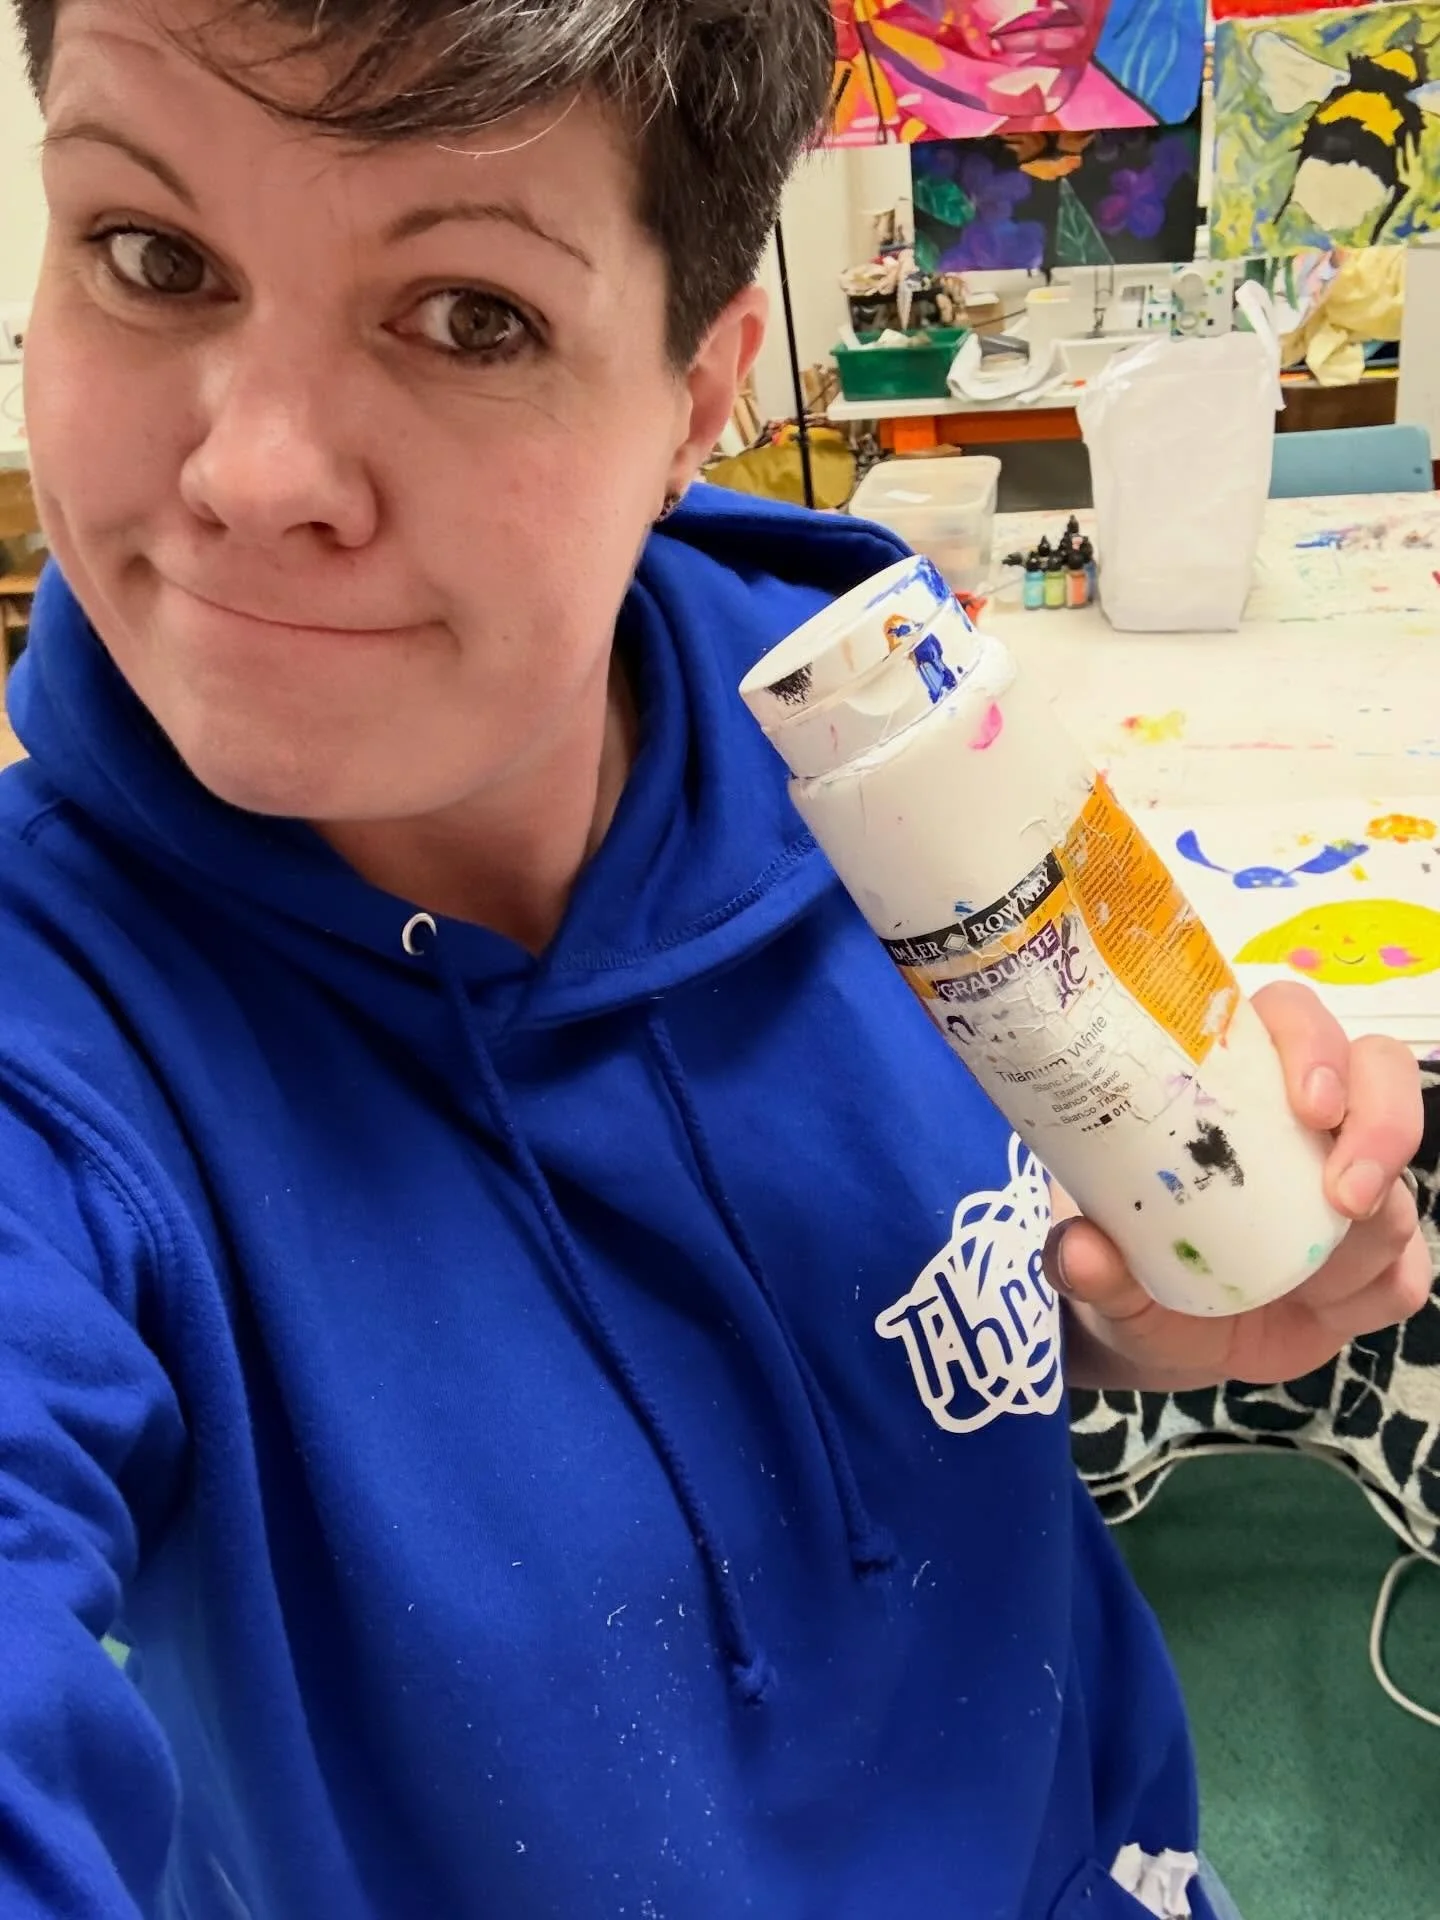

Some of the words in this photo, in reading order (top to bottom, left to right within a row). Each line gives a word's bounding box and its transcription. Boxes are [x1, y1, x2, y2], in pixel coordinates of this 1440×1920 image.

[890, 940, 945, 961] DALER
[970, 868, 1051, 941] ROWNEY
[939, 924, 1058, 999] GRADUATE
[996, 1057, 1068, 1083] Titanium
[1067, 1016, 1107, 1058] White
[1112, 1099, 1132, 1118] 011
[886, 1247, 1055, 1401] Thre
